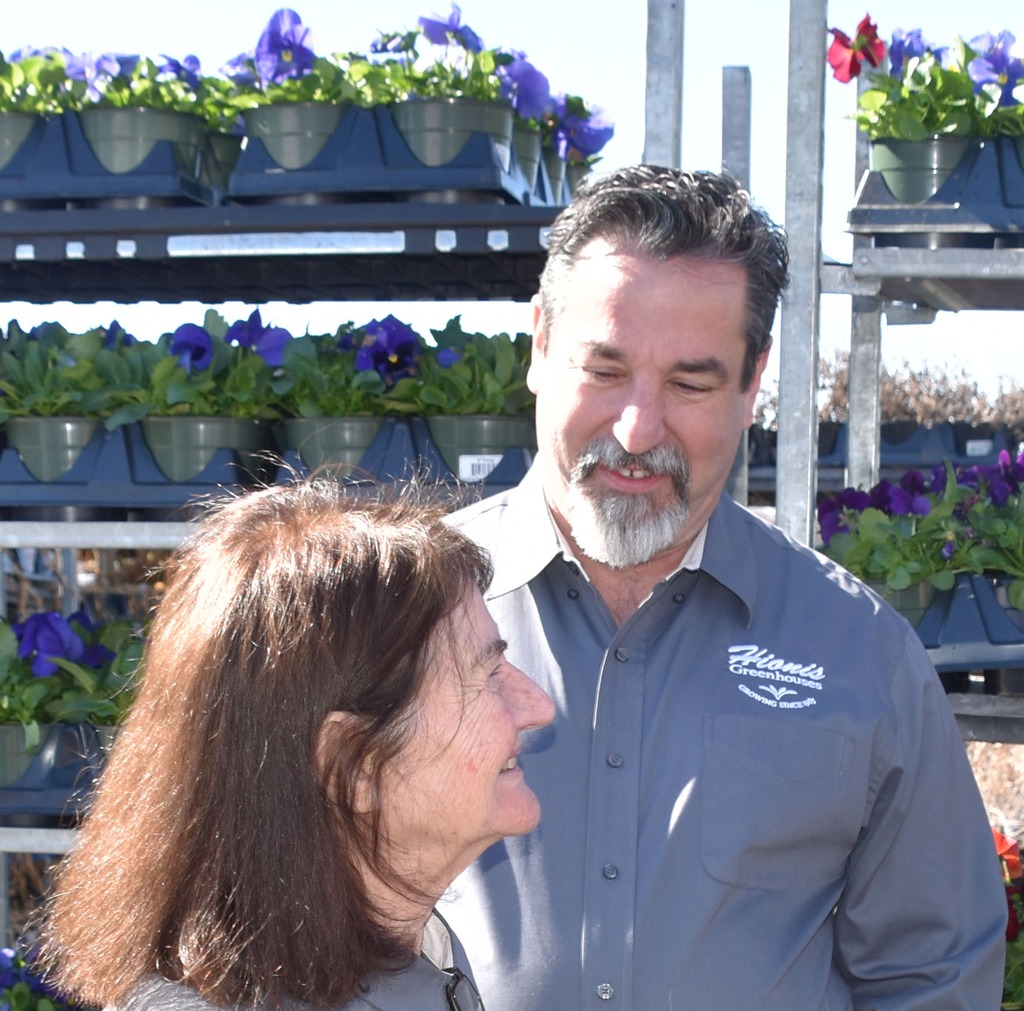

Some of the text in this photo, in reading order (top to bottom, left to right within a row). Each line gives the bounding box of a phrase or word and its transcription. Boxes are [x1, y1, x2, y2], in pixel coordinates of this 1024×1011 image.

[728, 644, 825, 680] Hionis
[728, 664, 823, 690] Greenhouses
[738, 684, 777, 708] GROWING
